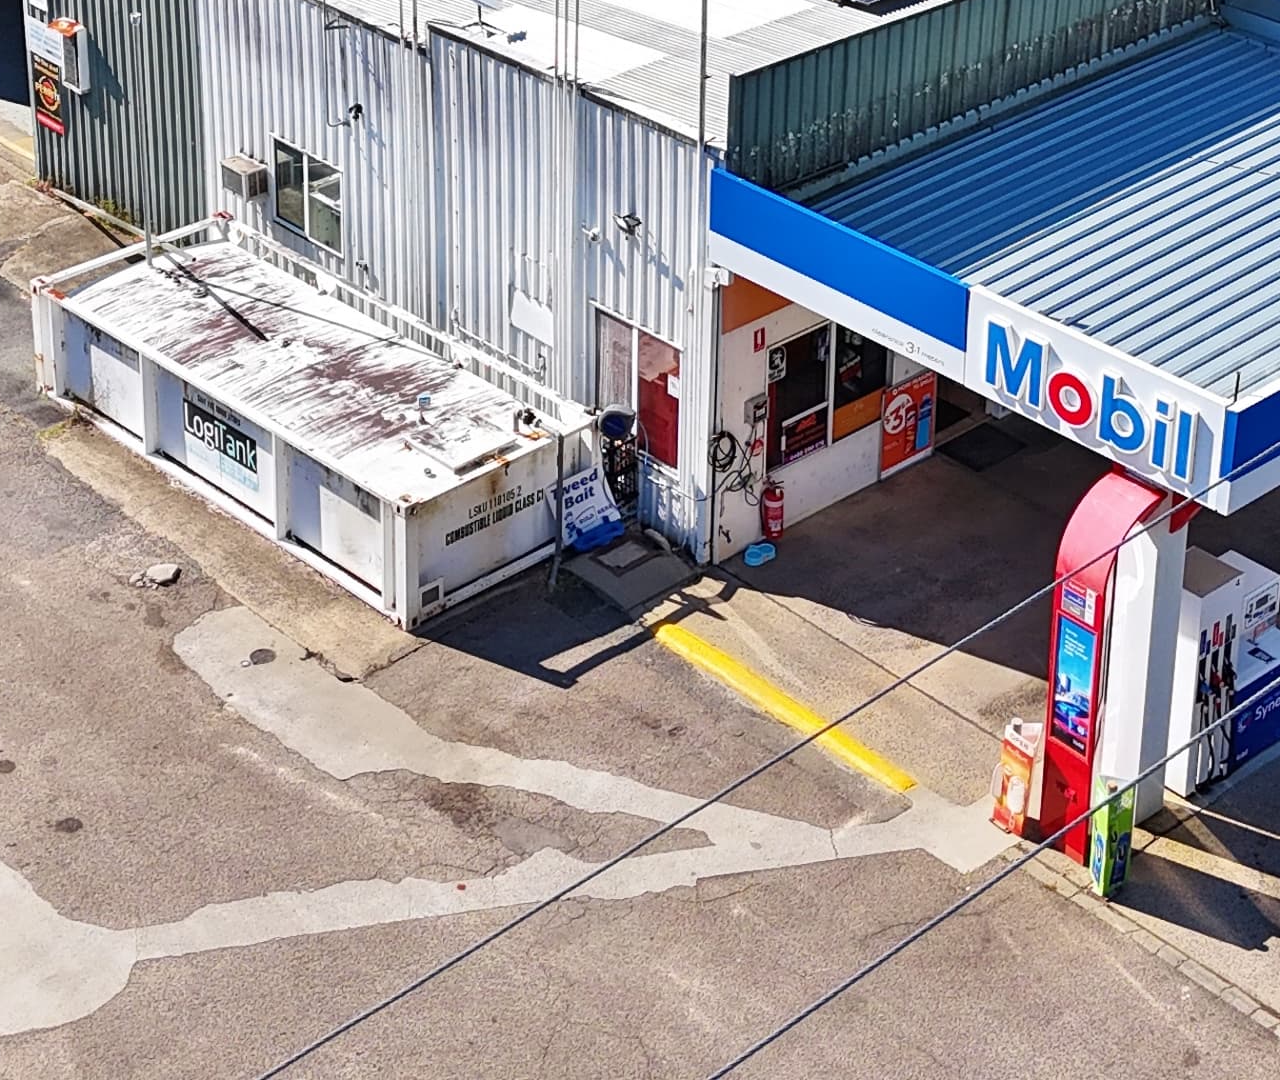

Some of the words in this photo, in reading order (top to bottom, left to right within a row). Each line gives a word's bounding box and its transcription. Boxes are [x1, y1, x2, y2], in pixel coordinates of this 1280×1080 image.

[984, 319, 1195, 483] Mobil
[184, 401, 257, 471] LogiTank
[468, 501, 488, 519] LSKU
[515, 492, 535, 513] CLASS
[564, 486, 595, 510] Bait
